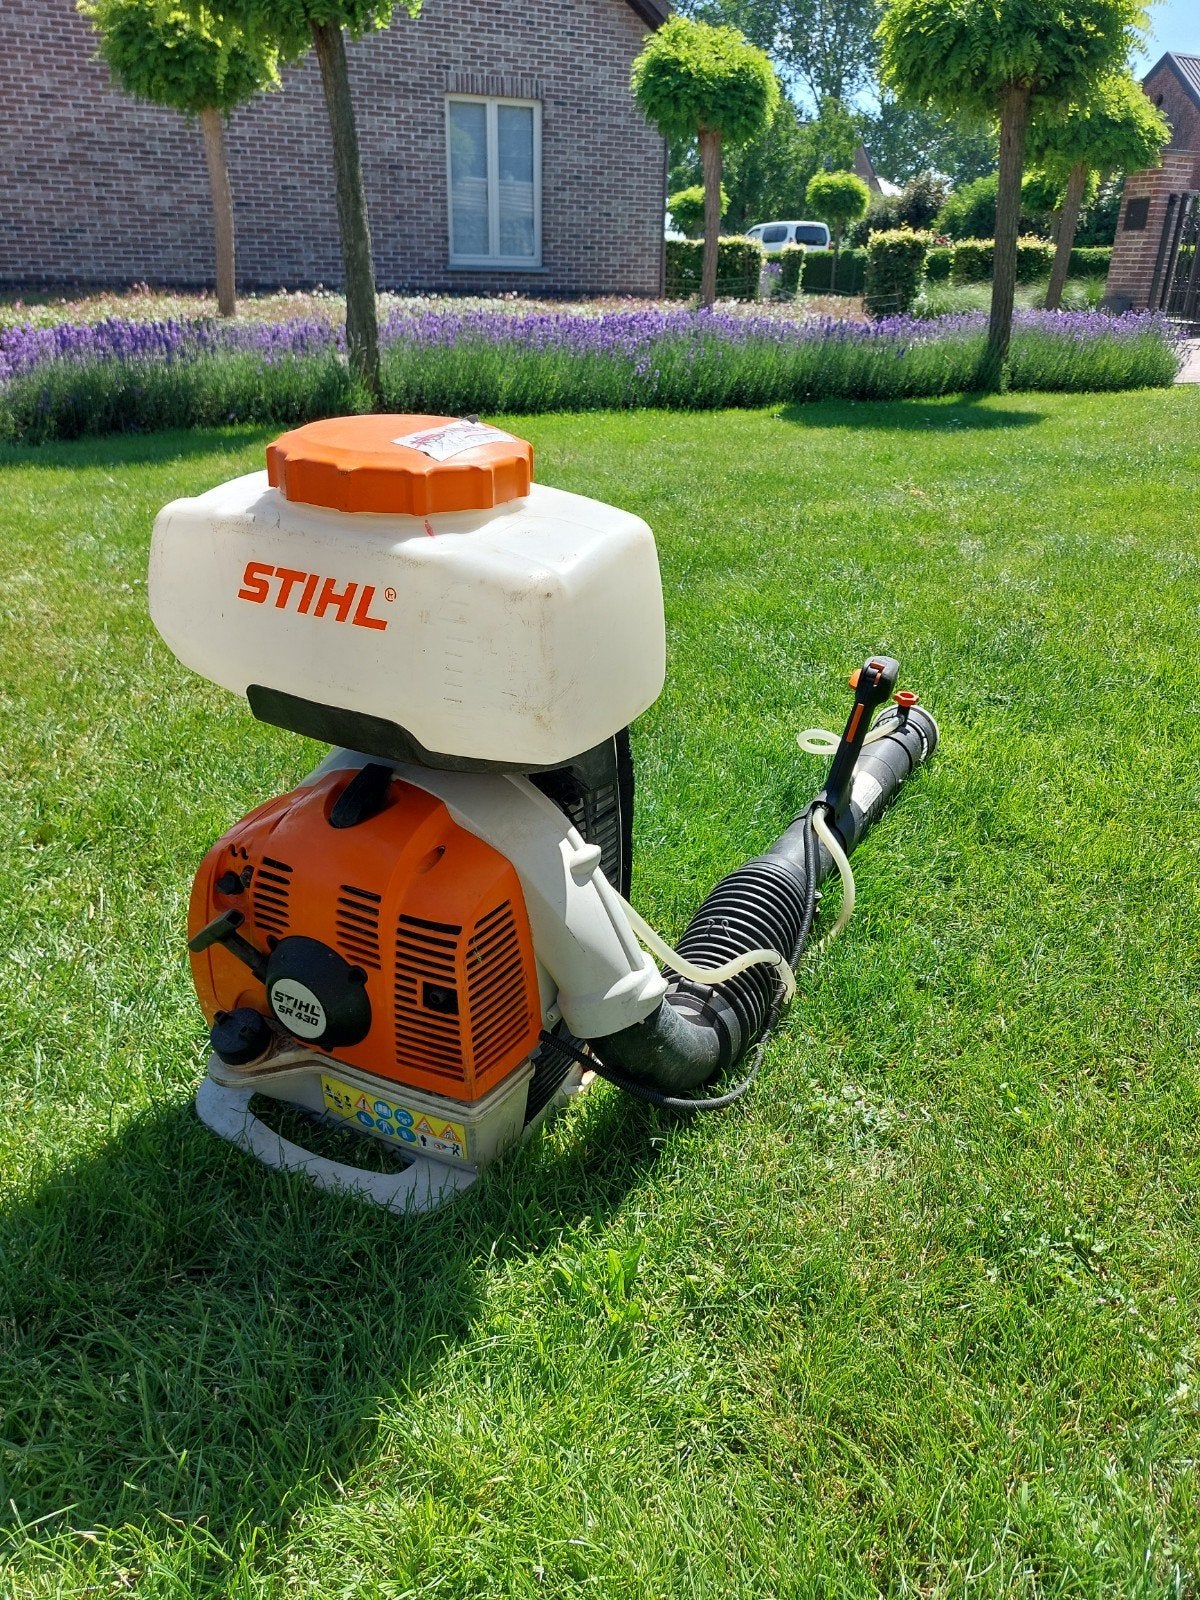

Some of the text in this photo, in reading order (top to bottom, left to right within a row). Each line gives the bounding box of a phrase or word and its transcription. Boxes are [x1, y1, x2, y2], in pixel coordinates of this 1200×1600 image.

[237, 561, 388, 631] STIHL
[273, 990, 321, 1018] STIHL
[277, 1004, 319, 1027] SR 430
